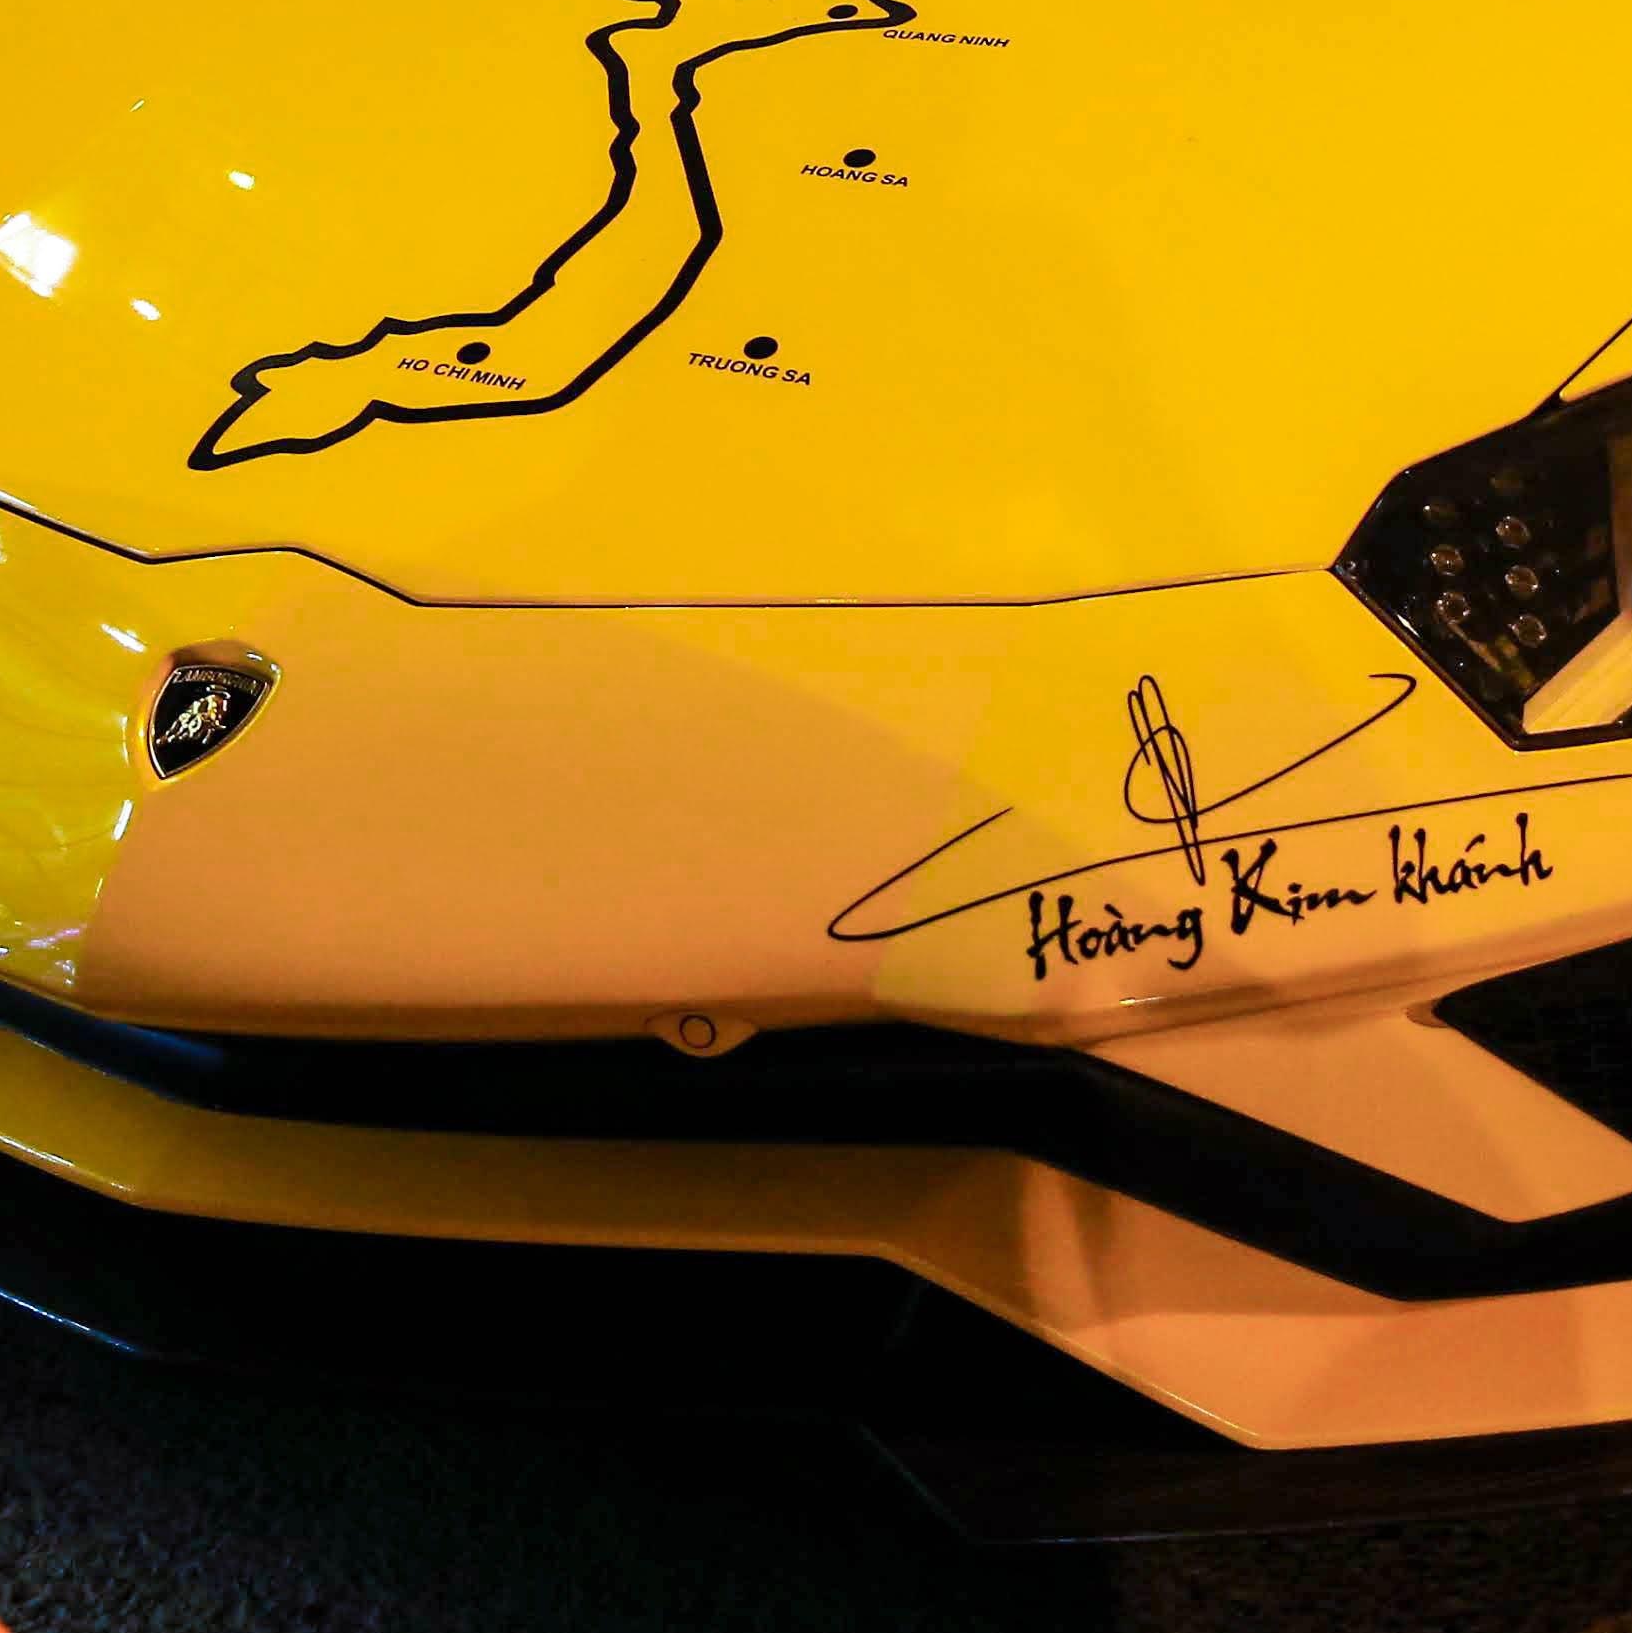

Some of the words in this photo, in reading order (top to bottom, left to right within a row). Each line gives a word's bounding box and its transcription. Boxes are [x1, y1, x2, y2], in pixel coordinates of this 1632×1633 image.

[882, 28, 957, 44] QUANG
[958, 35, 1010, 48] NINH
[800, 164, 878, 183] HOANG
[880, 174, 908, 187] SA
[397, 357, 429, 372] HO
[433, 363, 470, 381] CHI
[469, 370, 527, 391] MINH
[688, 352, 780, 379] TRUONG
[781, 369, 811, 386] SA
[1026, 891, 1203, 980] Hoàng
[1221, 838, 1377, 935] Kim
